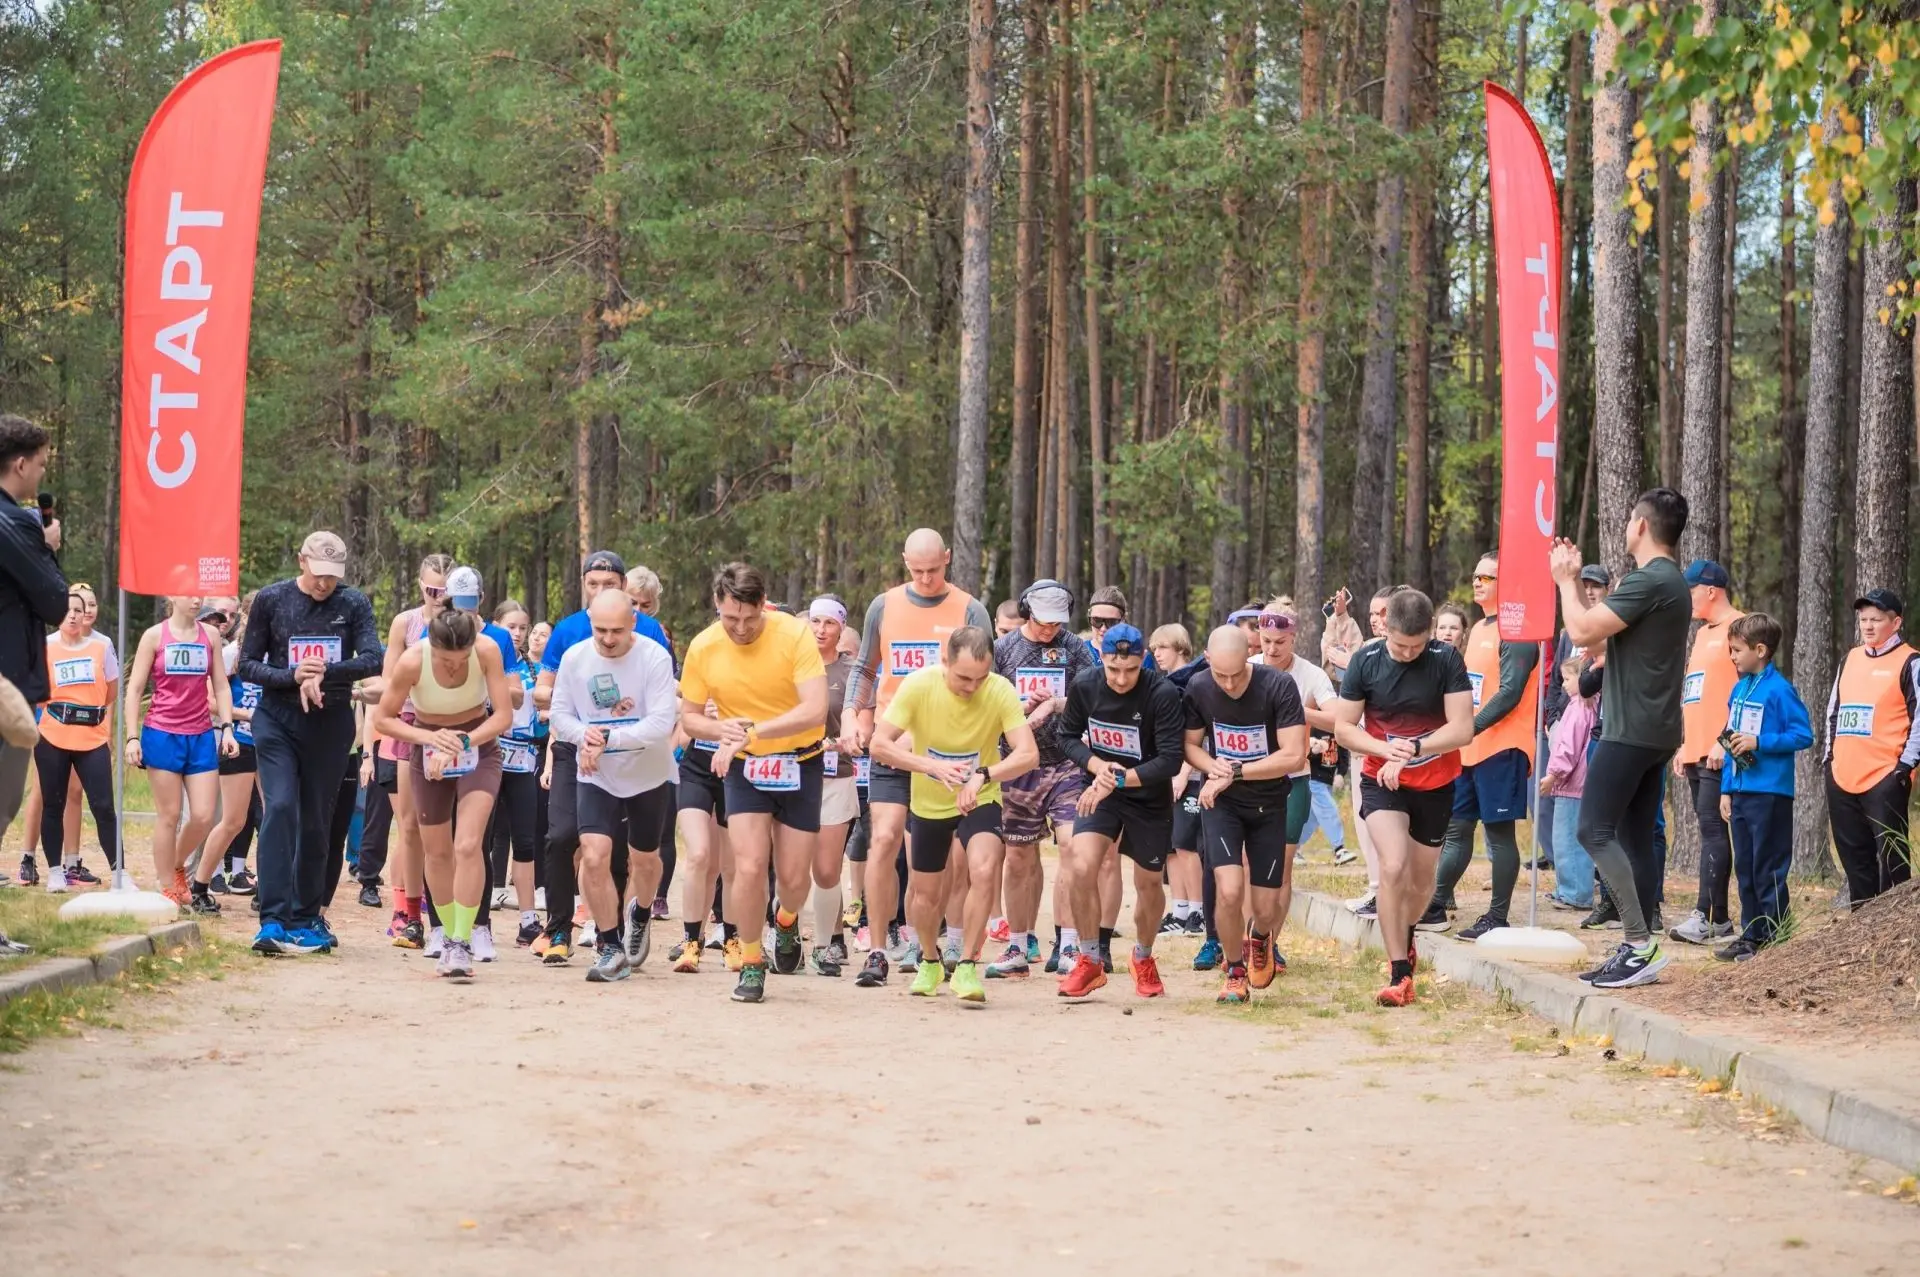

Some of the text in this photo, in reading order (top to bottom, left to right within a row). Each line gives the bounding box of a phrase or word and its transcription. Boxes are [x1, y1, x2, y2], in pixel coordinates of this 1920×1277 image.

[147, 191, 224, 489] СТАРТ
[172, 650, 190, 665] 70
[292, 645, 324, 663] 140
[893, 650, 925, 668] 145
[61, 666, 76, 679] 81
[1839, 712, 1858, 728] 103
[1092, 728, 1124, 748] 139
[1217, 731, 1248, 752] 148
[749, 760, 782, 779] 144
